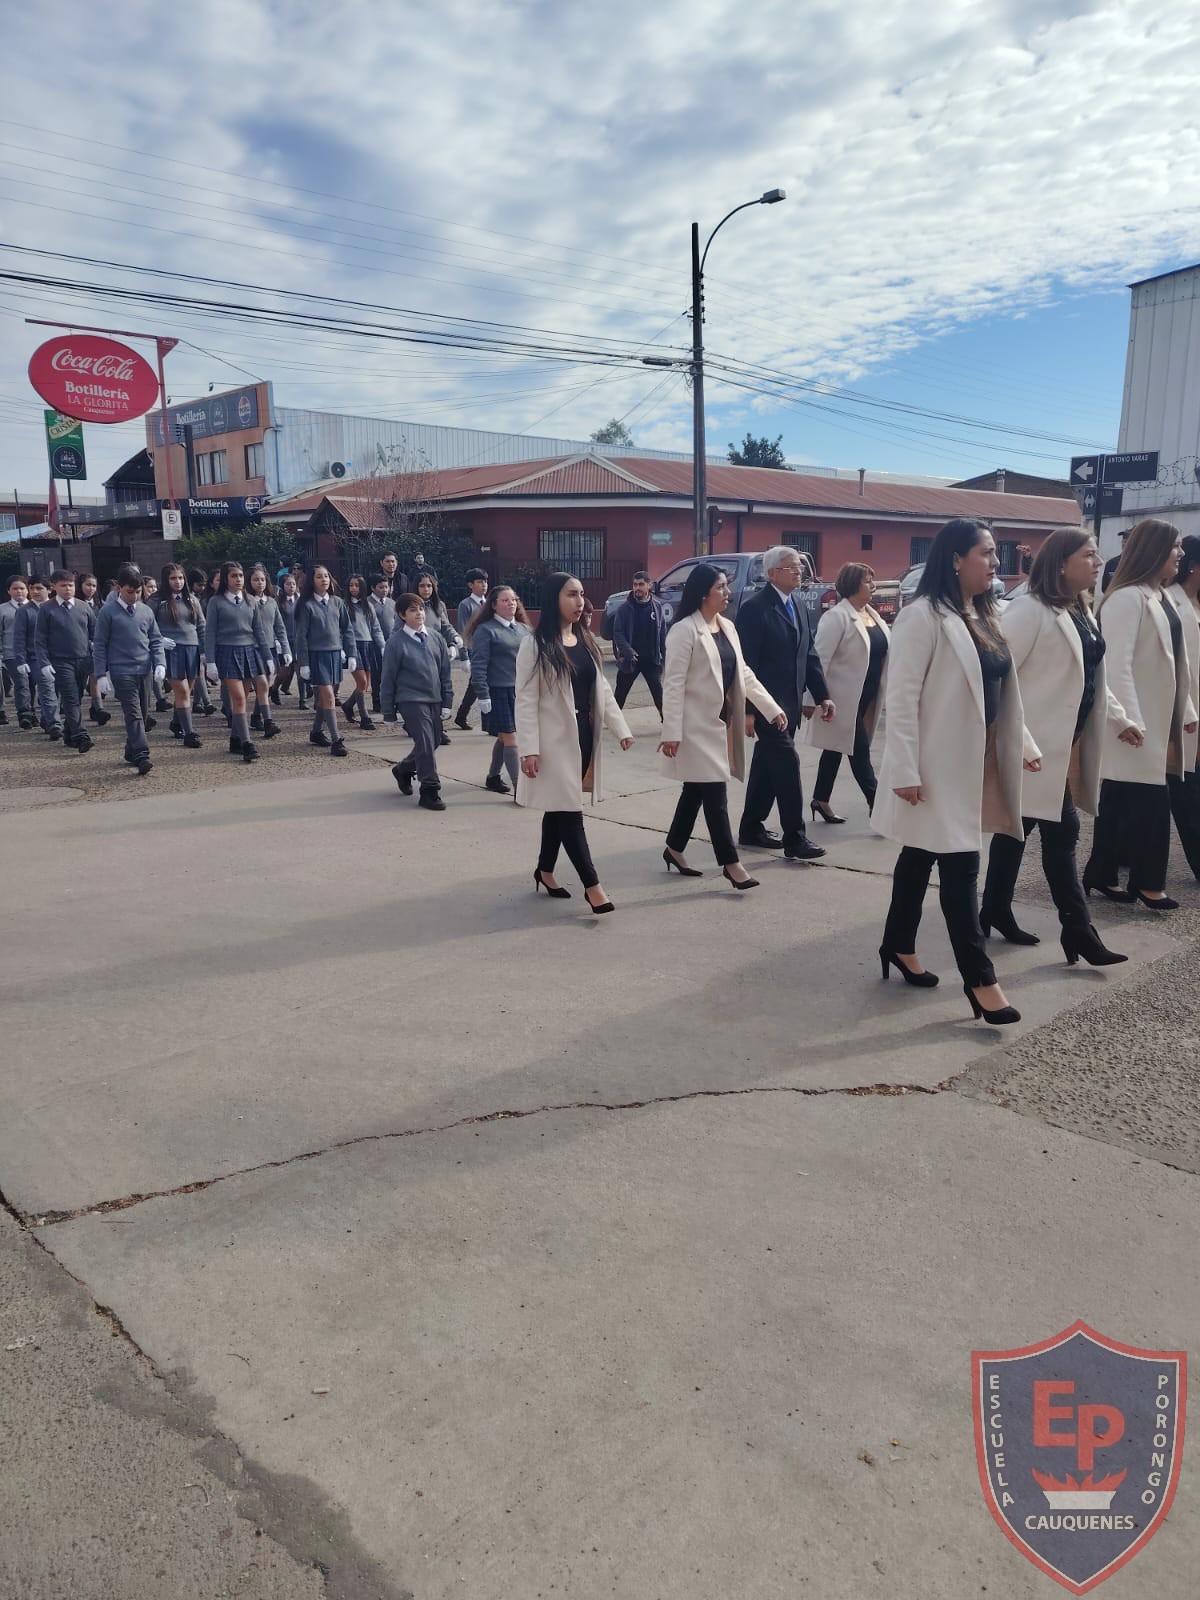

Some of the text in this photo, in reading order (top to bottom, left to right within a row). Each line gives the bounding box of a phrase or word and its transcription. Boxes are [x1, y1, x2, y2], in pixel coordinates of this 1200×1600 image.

[51, 348, 136, 381] Coca-Cola
[68, 395, 129, 411] LA GLORITA
